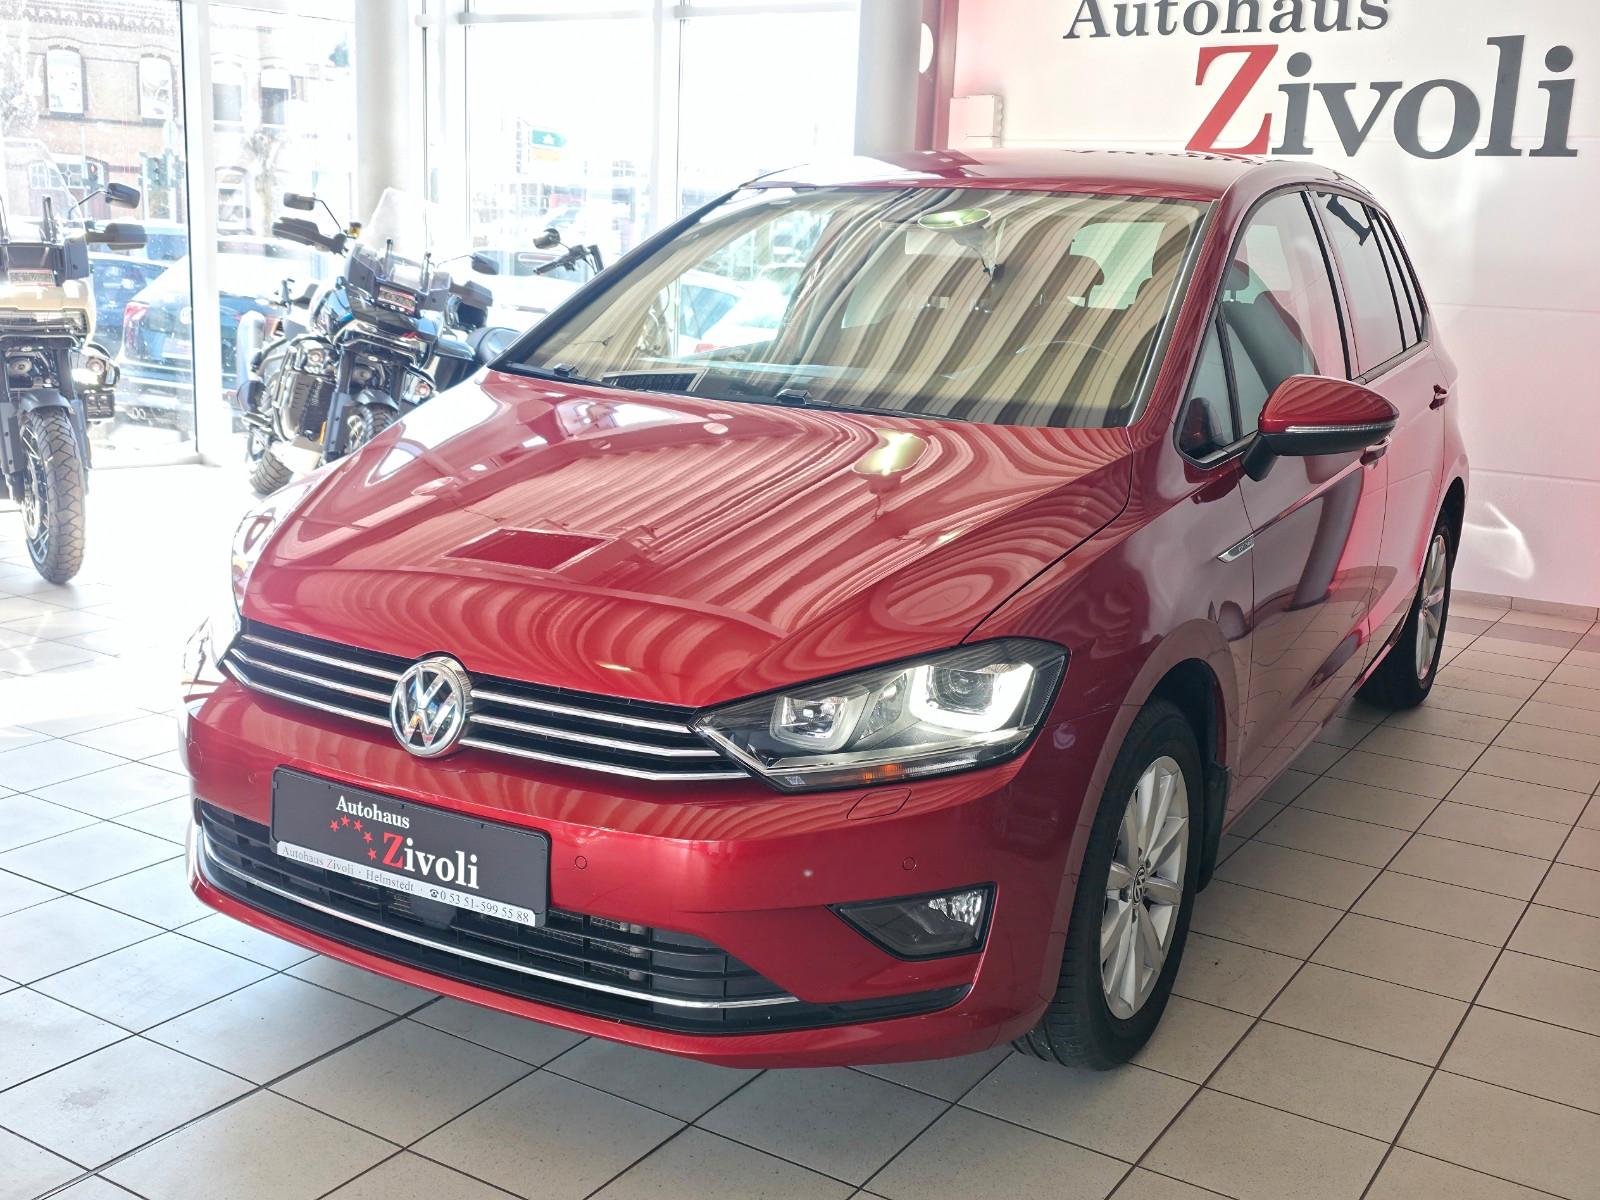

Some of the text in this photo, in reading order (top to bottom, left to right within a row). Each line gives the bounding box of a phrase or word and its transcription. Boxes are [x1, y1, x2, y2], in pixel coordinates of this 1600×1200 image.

[1062, 0, 1389, 39] Autohaus
[1185, 35, 1578, 159] Zivoli
[336, 795, 410, 829] Autohaus
[282, 846, 529, 923] Autohaus Zivoli Helmstedt 0 53 51-599 55 88
[383, 832, 479, 889] Zivoli
